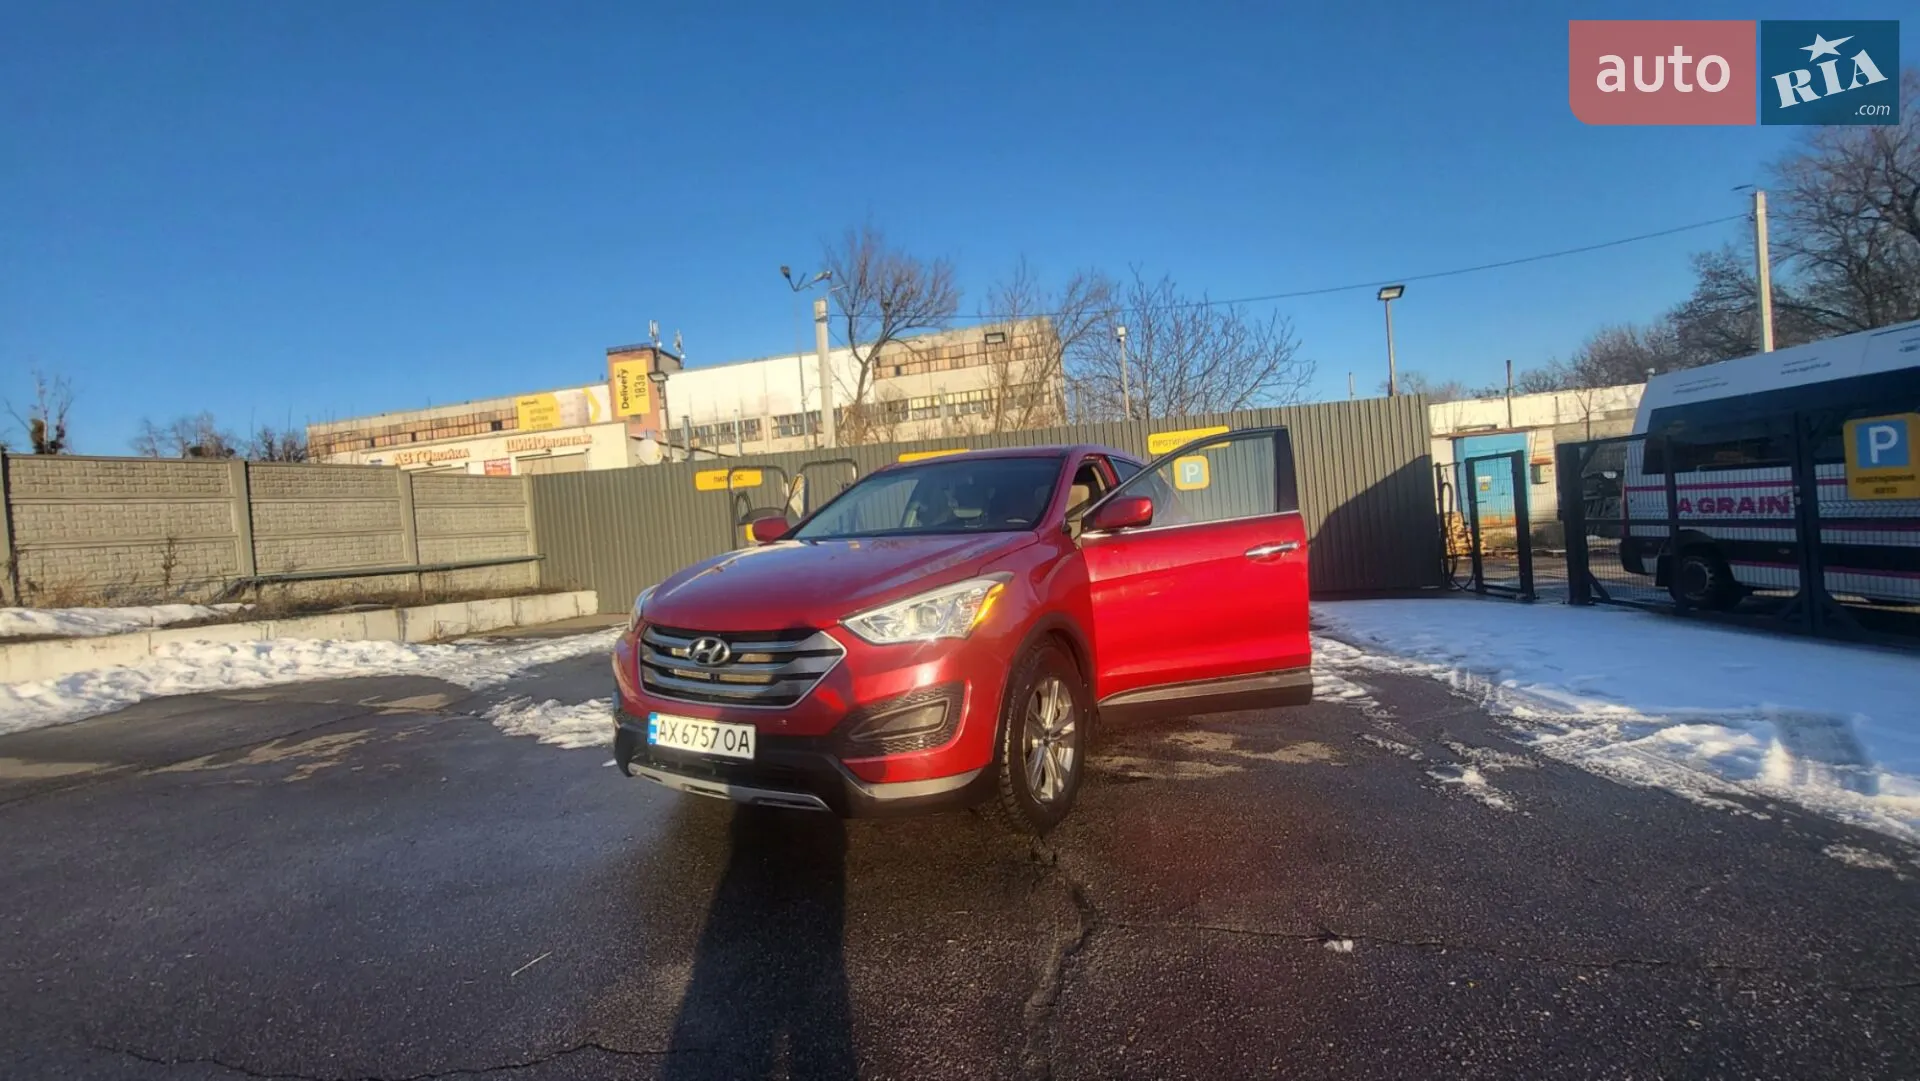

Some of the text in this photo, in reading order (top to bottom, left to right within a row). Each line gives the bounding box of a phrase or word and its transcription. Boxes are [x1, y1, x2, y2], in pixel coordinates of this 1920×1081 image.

[617, 368, 630, 410] Delivery
[1868, 425, 1899, 465] P
[1184, 463, 1199, 483] P
[659, 720, 750, 753] AX 6757 OA
